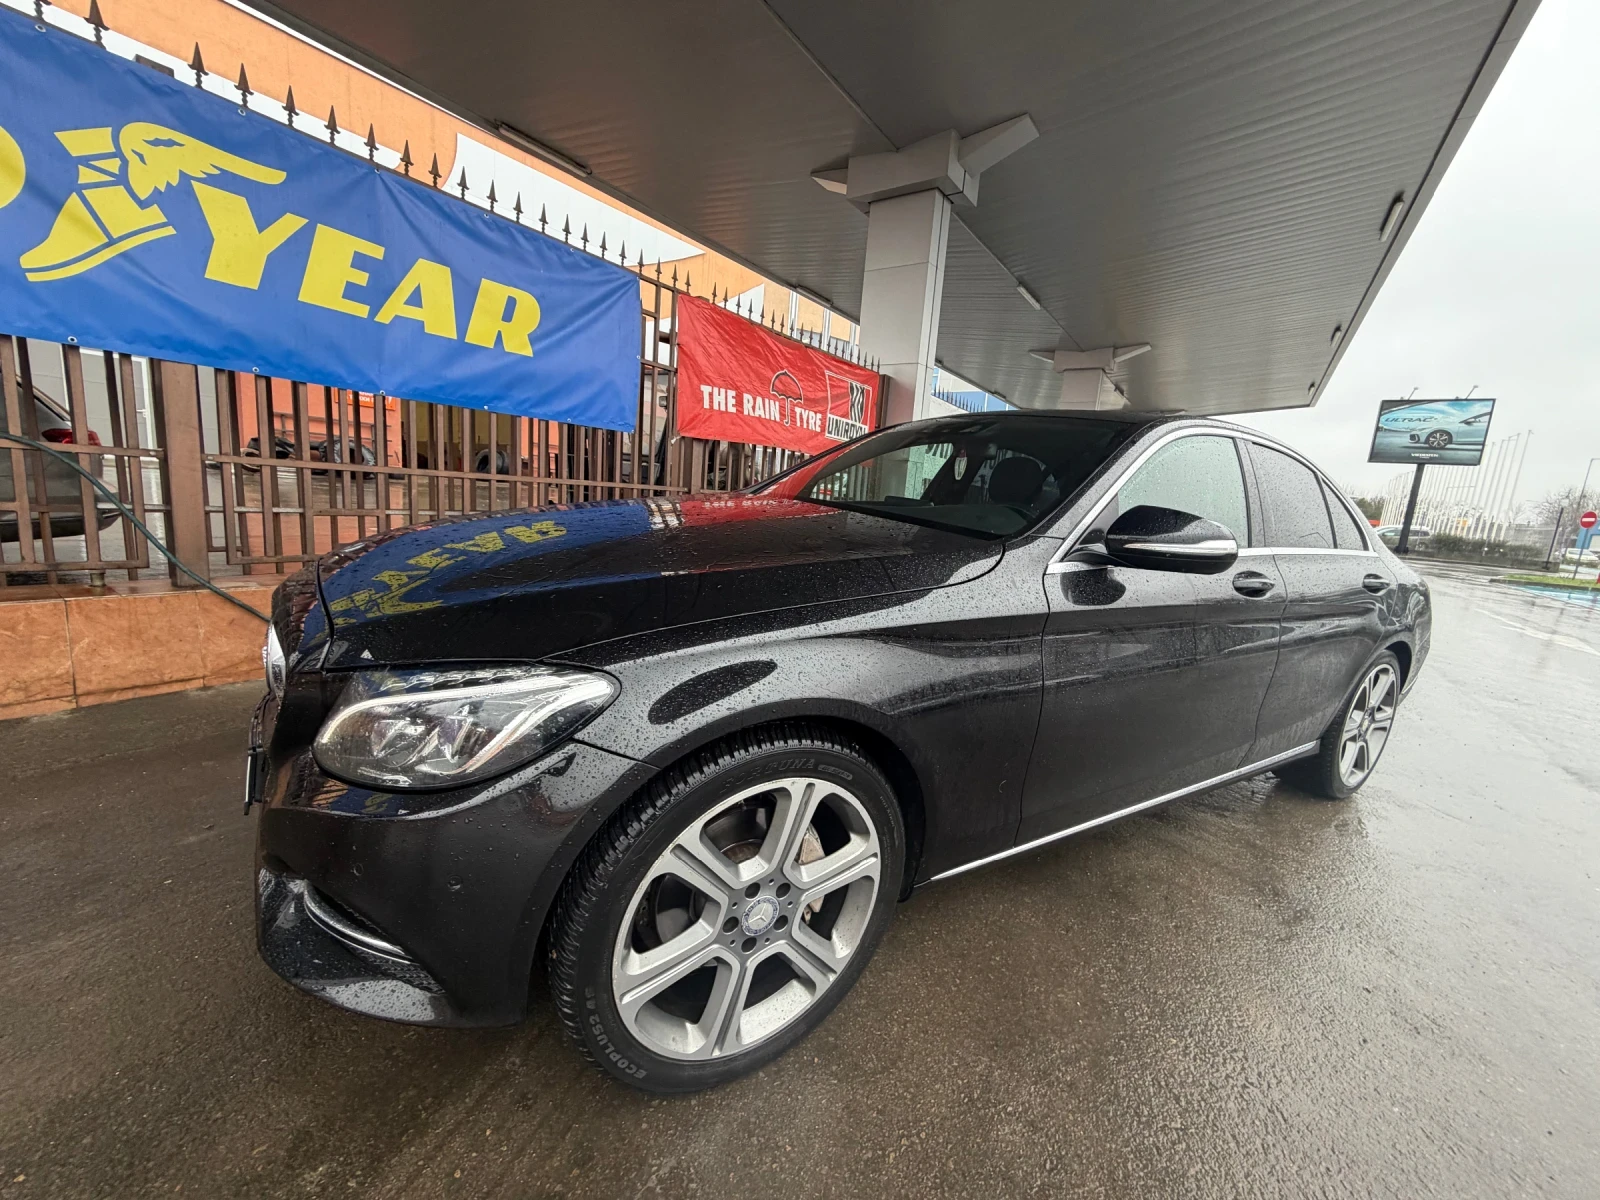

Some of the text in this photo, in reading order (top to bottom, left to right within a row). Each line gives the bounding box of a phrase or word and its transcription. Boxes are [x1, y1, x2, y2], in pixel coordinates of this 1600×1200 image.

[191, 180, 541, 357] YEAR
[700, 384, 822, 433] THE RAIN TYRE
